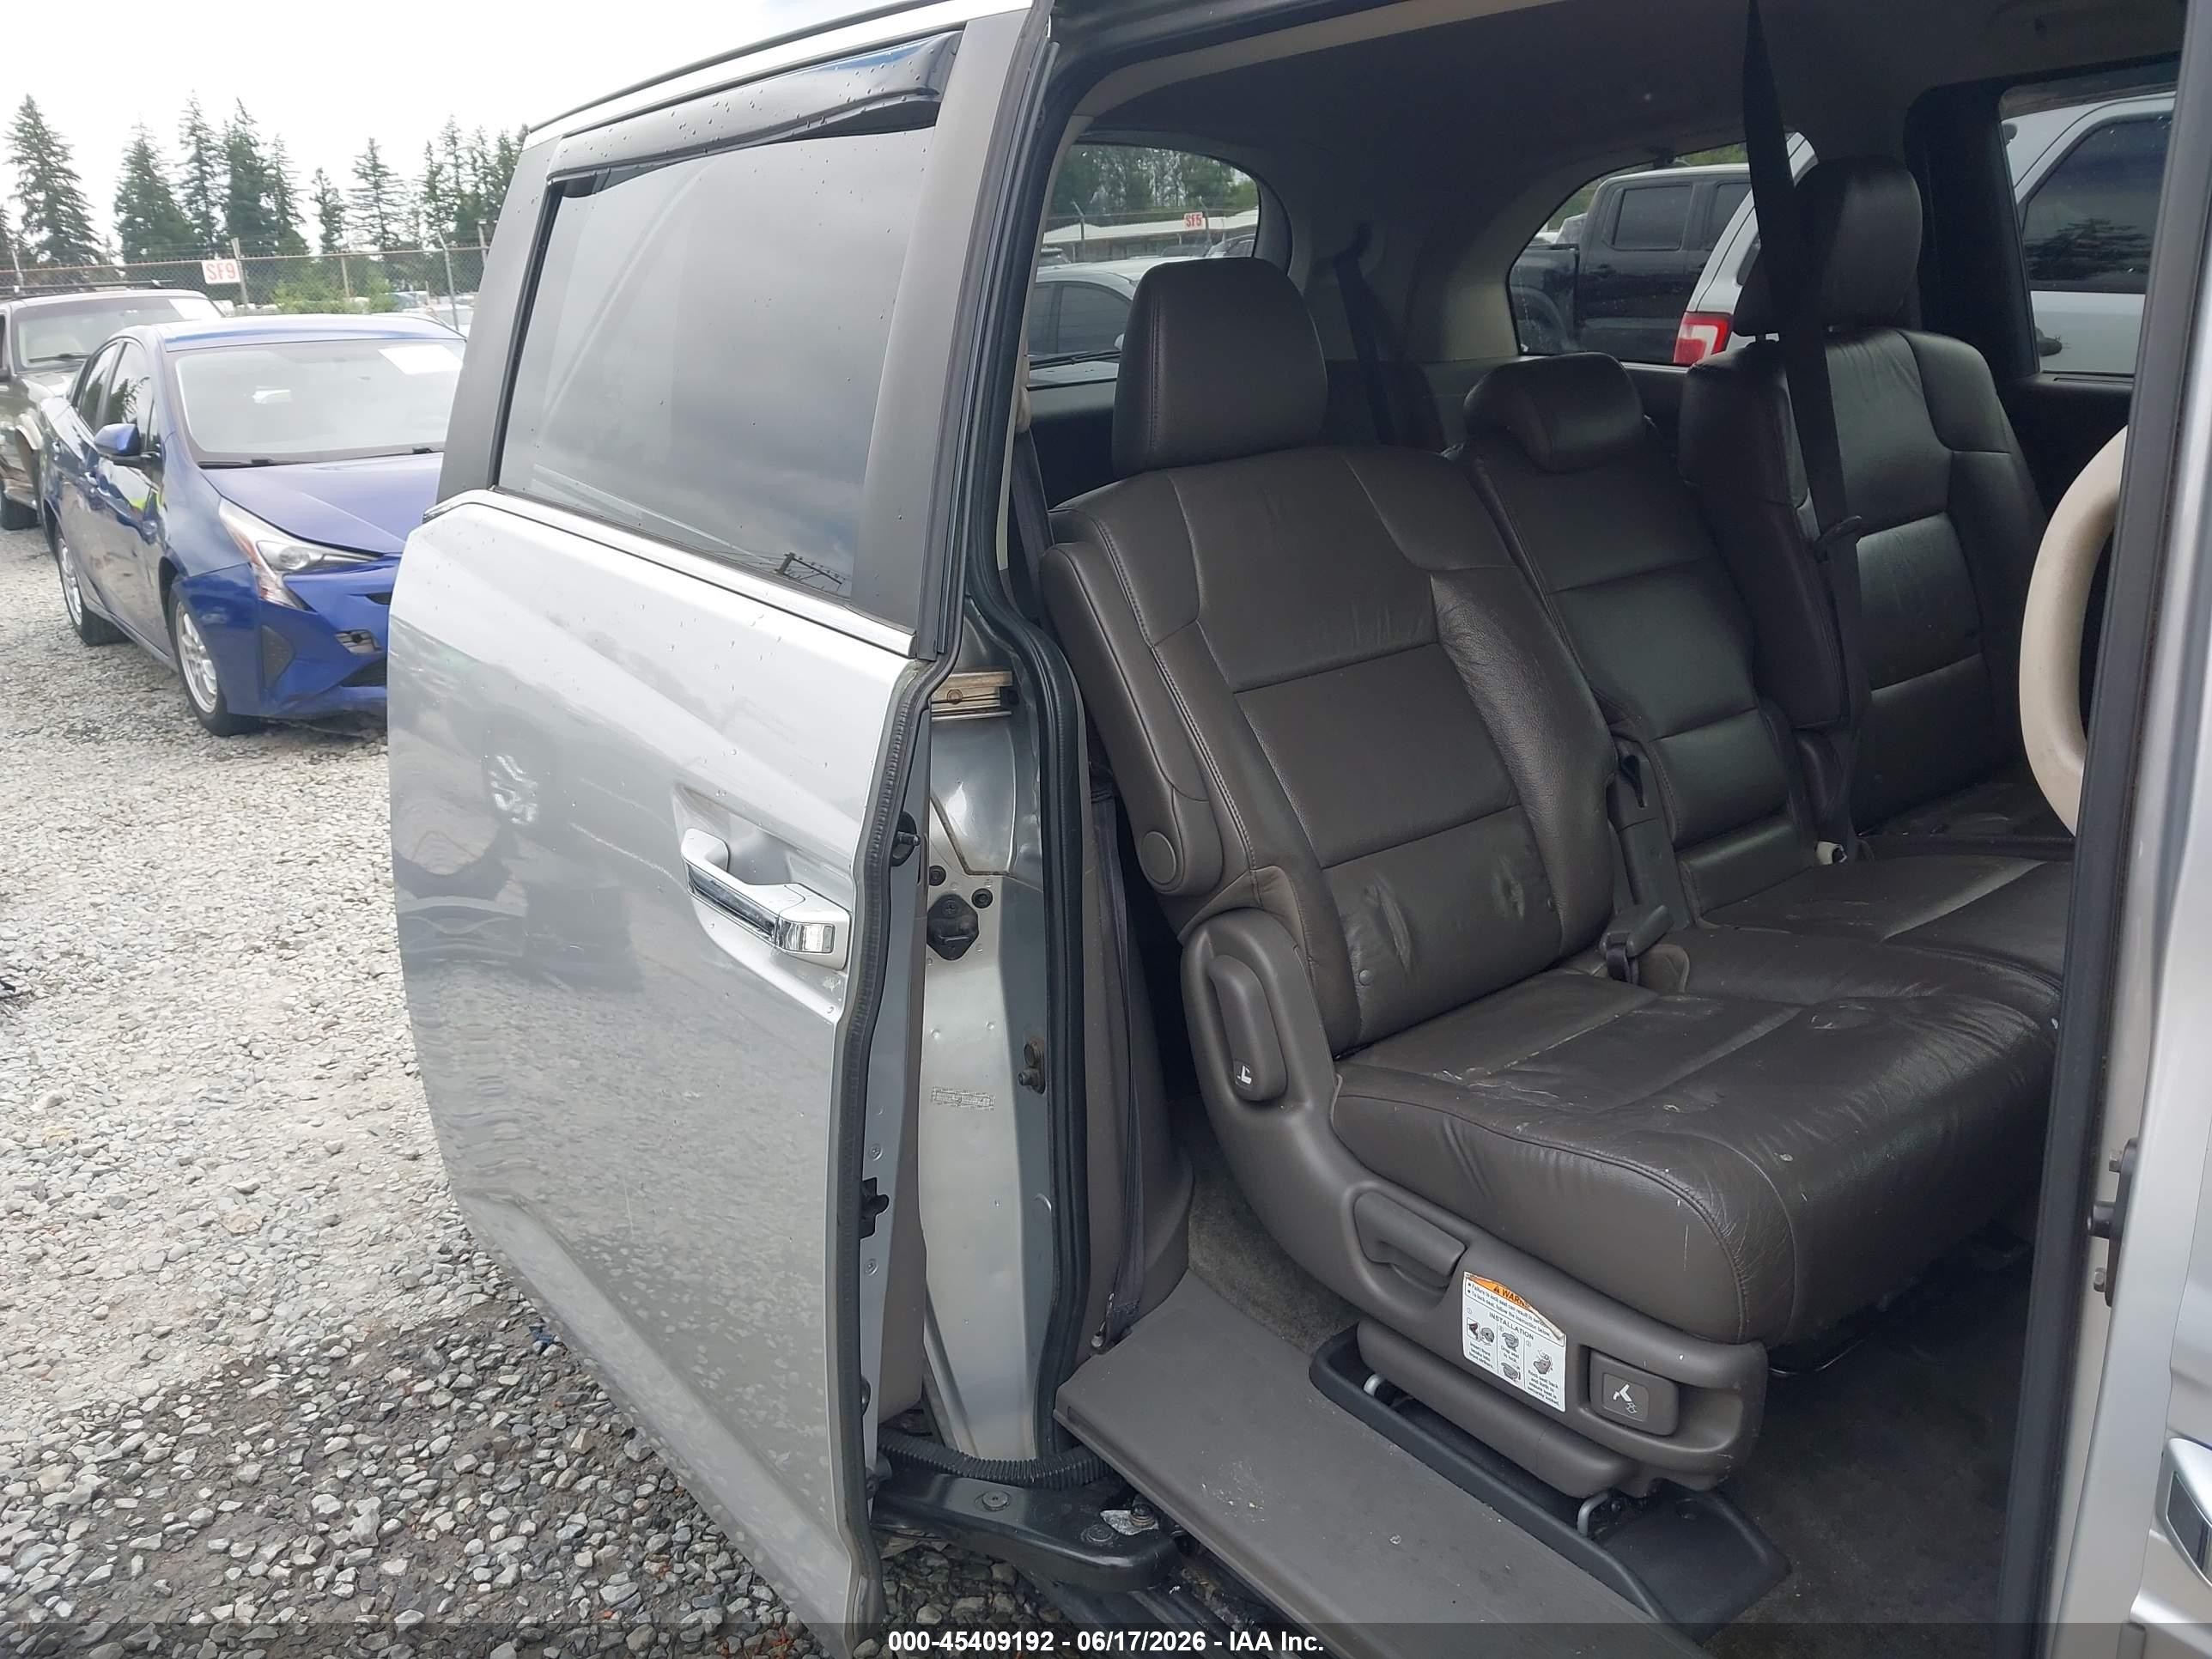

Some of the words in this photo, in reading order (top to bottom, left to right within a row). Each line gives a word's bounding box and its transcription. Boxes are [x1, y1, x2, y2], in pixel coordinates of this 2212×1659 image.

[1185, 213, 1202, 228] SF5
[206, 262, 236, 281] SF9
[1489, 1311, 1534, 1340] INSTALLATION
